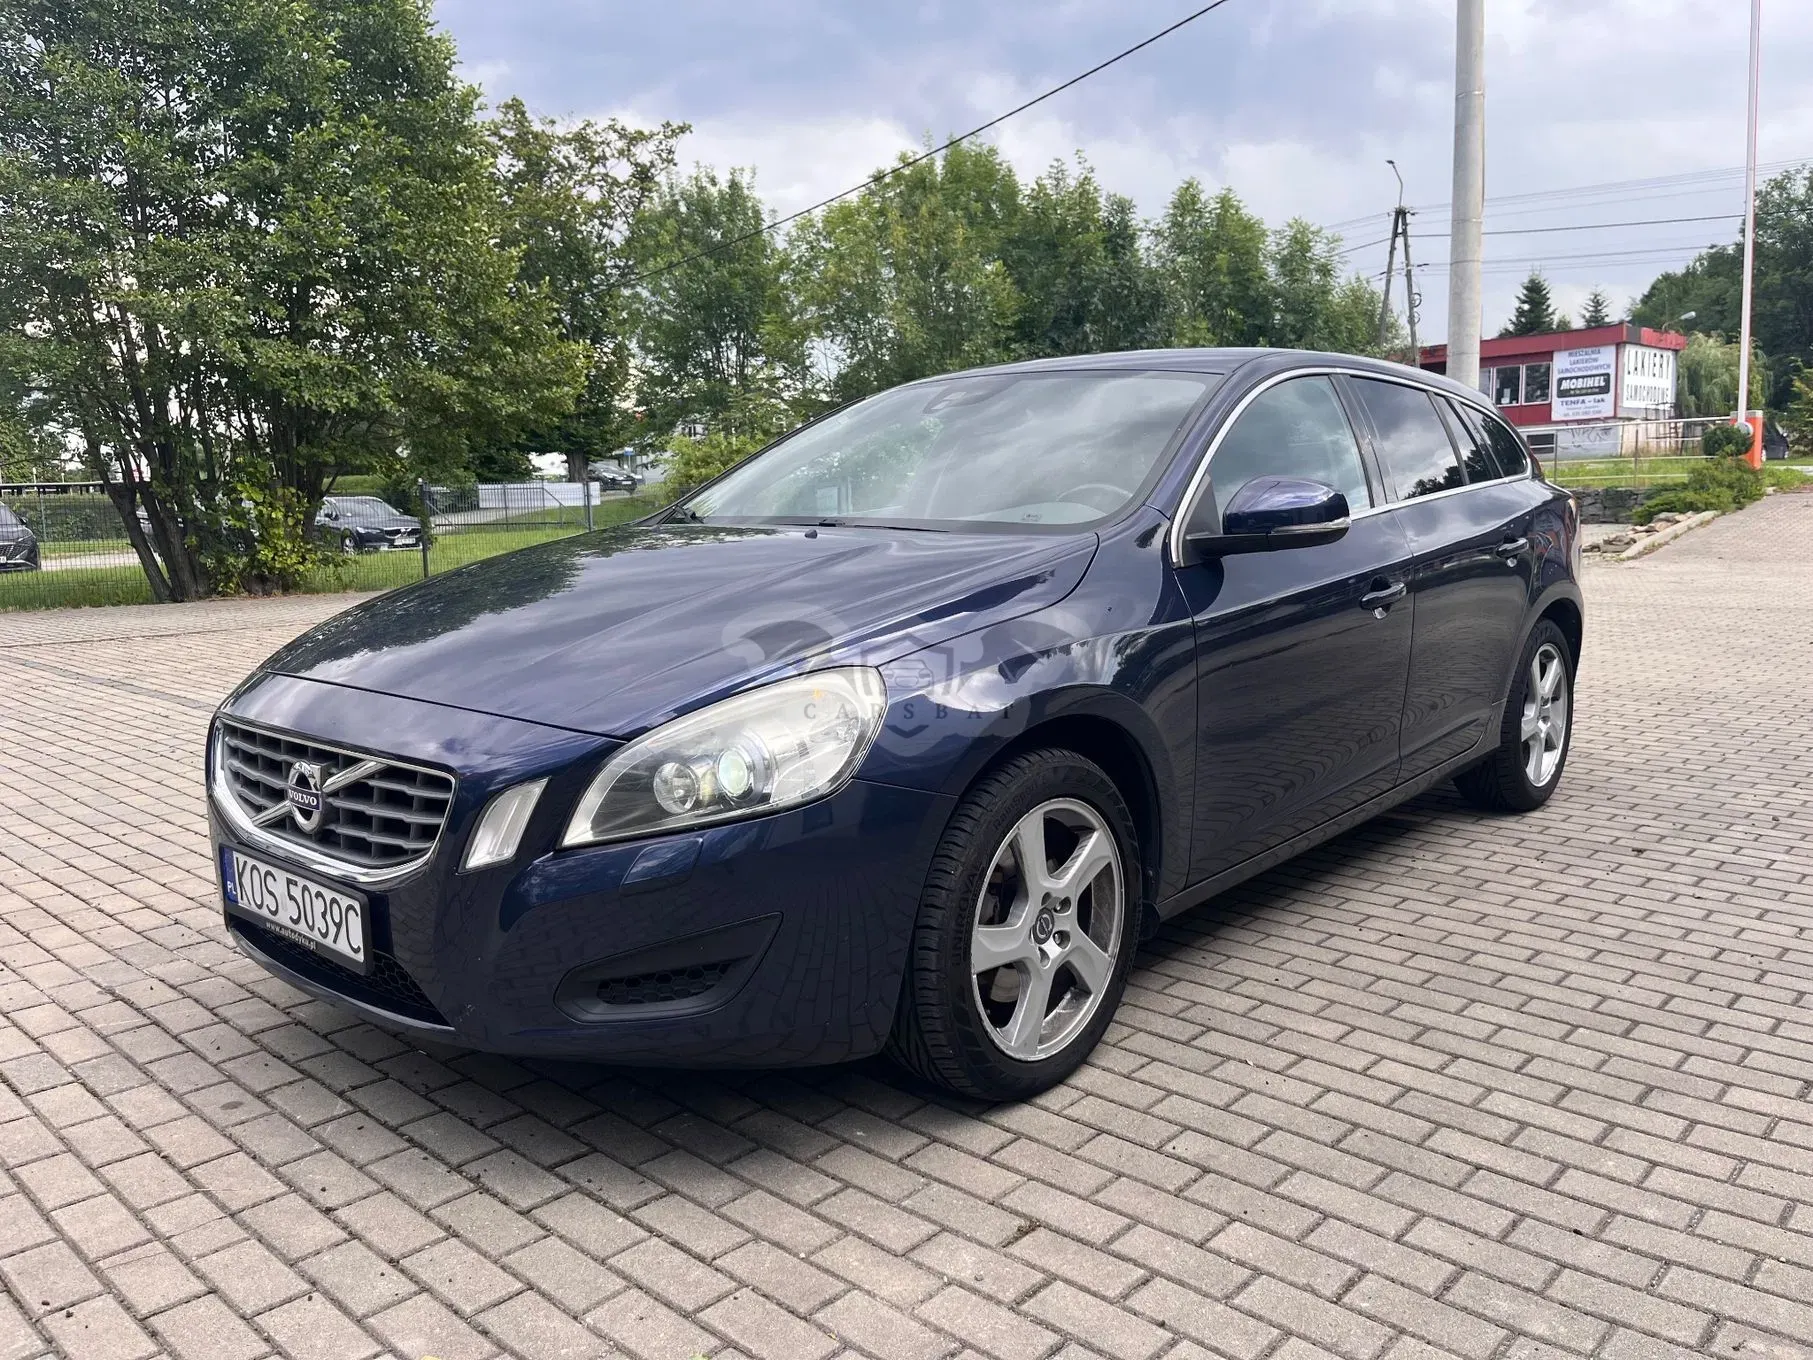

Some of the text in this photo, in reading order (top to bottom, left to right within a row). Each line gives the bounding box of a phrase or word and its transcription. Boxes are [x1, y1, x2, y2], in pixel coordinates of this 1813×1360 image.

[1627, 349, 1671, 379] LAKIERY
[1560, 375, 1606, 390] MOBIHEL
[289, 788, 317, 806] VOLVO
[227, 881, 237, 895] PL
[235, 856, 362, 955] KOS 5039C
